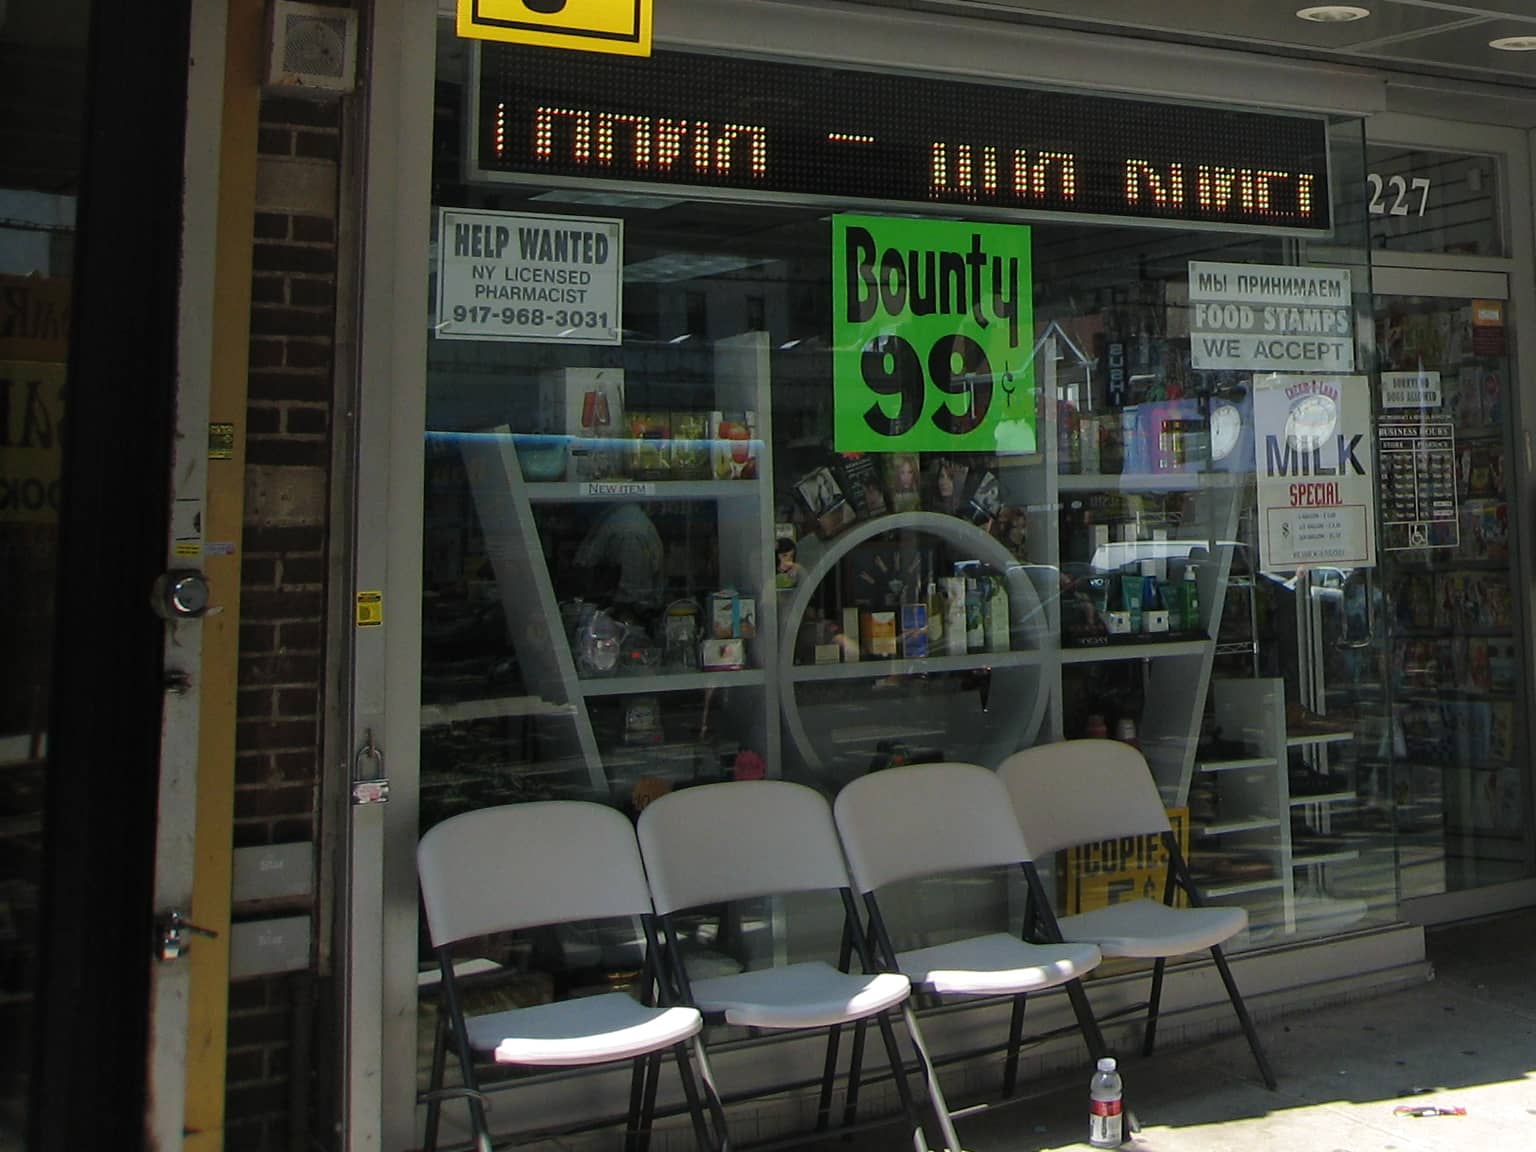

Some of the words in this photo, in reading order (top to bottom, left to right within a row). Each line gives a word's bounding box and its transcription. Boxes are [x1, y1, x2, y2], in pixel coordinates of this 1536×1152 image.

[1366, 173, 1431, 217] 227
[455, 223, 510, 259] HELP
[518, 227, 609, 265] WANTED
[472, 265, 496, 279] NY
[505, 267, 591, 285] LICENSED
[846, 225, 1019, 348] Bounty
[1198, 272, 1228, 293] МЫ
[1237, 274, 1342, 298] ПРИНИМАЕМ
[475, 284, 588, 304] PHARMACIST
[453, 305, 609, 329] 917-968-3031
[1195, 304, 1256, 330] FOOD
[1263, 307, 1349, 335] STAMPS
[1203, 339, 1241, 359] WE
[1253, 341, 1344, 362] ACCEPT
[1378, 427, 1418, 437] BUSINESS
[1266, 433, 1366, 478] MILK
[1289, 482, 1343, 506] SPECIAL
